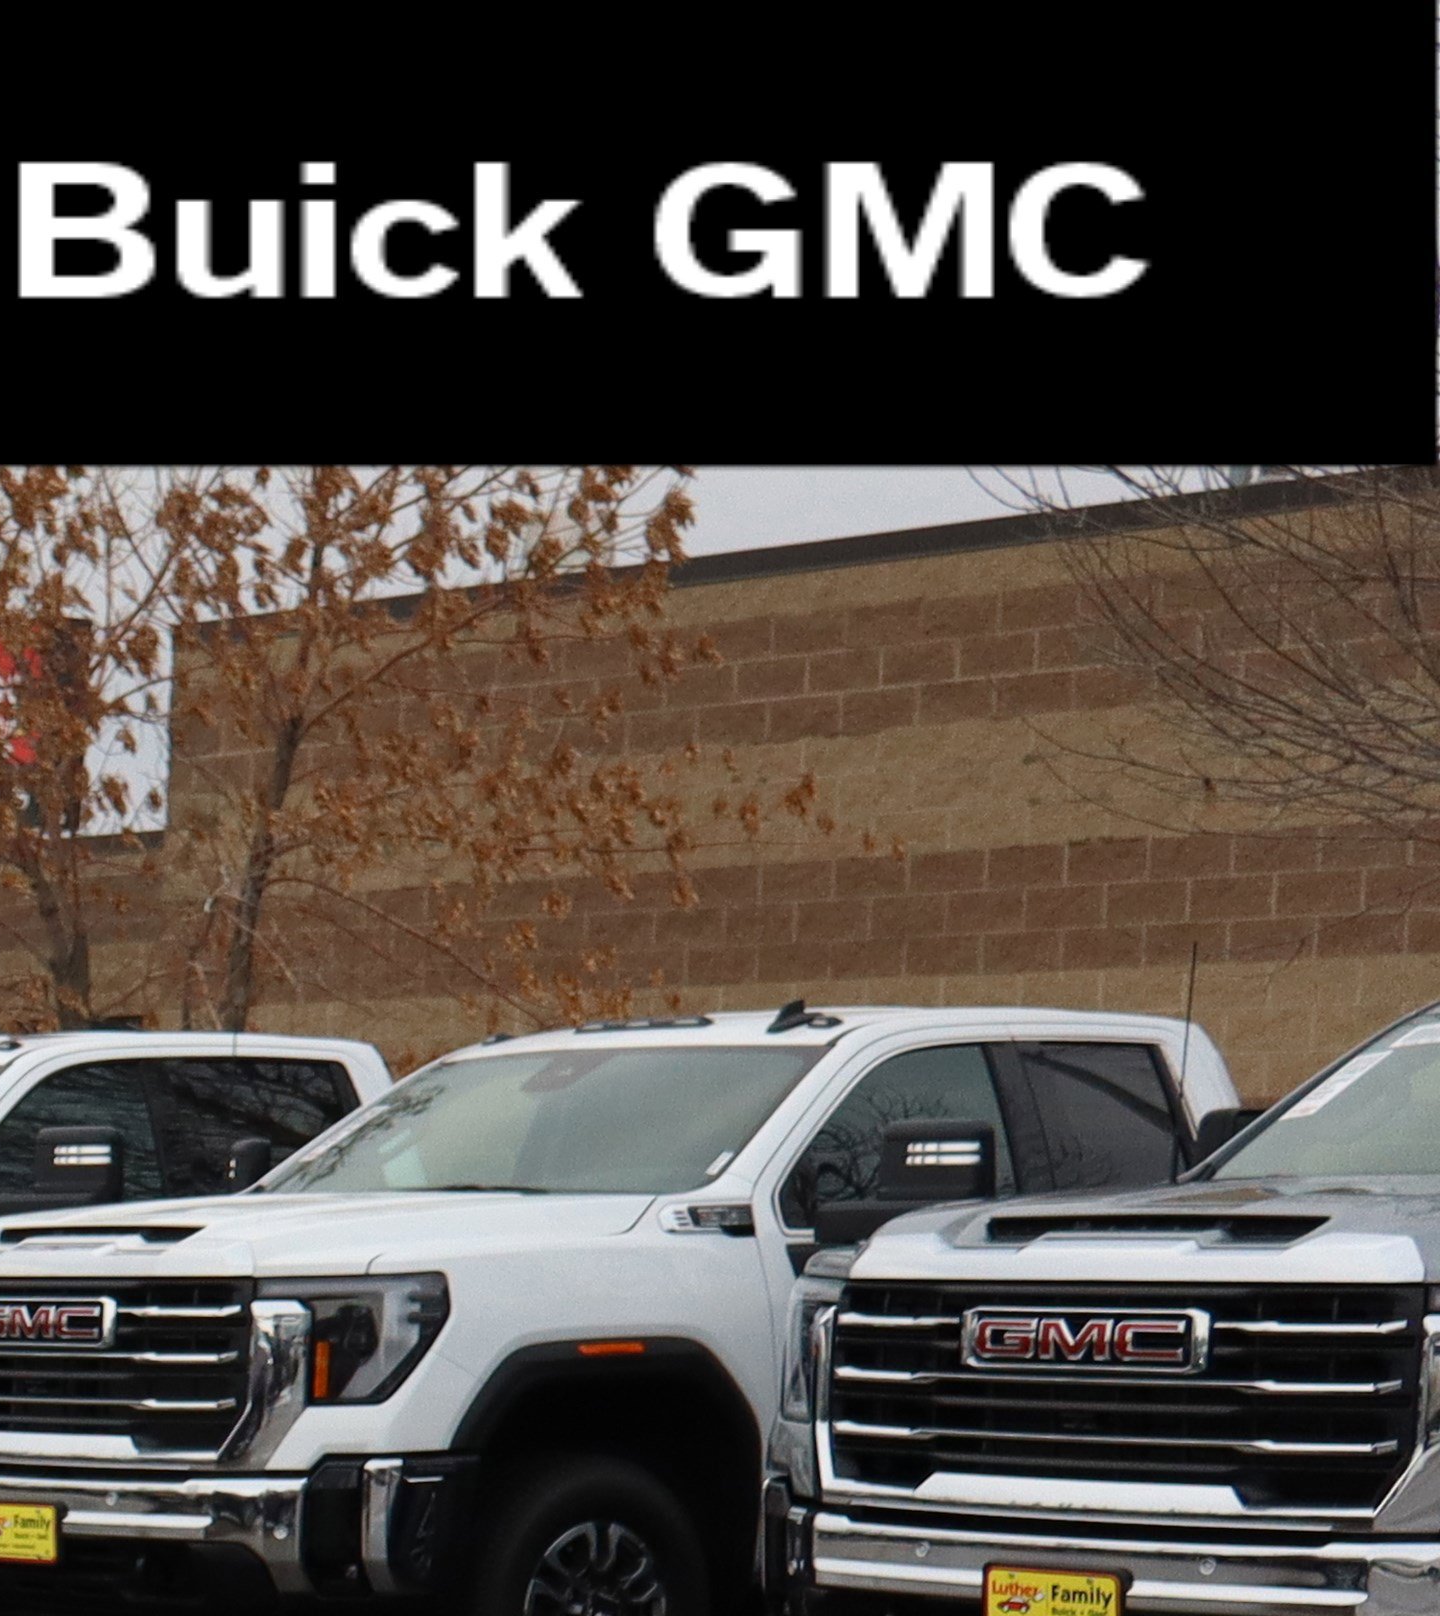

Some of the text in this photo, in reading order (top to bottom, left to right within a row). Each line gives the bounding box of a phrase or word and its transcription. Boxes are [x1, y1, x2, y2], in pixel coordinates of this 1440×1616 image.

[976, 1317, 1185, 1362] GMC
[14, 1514, 50, 1531] Family
[992, 1580, 1039, 1597] Luther
[1051, 1585, 1113, 1609] Family
